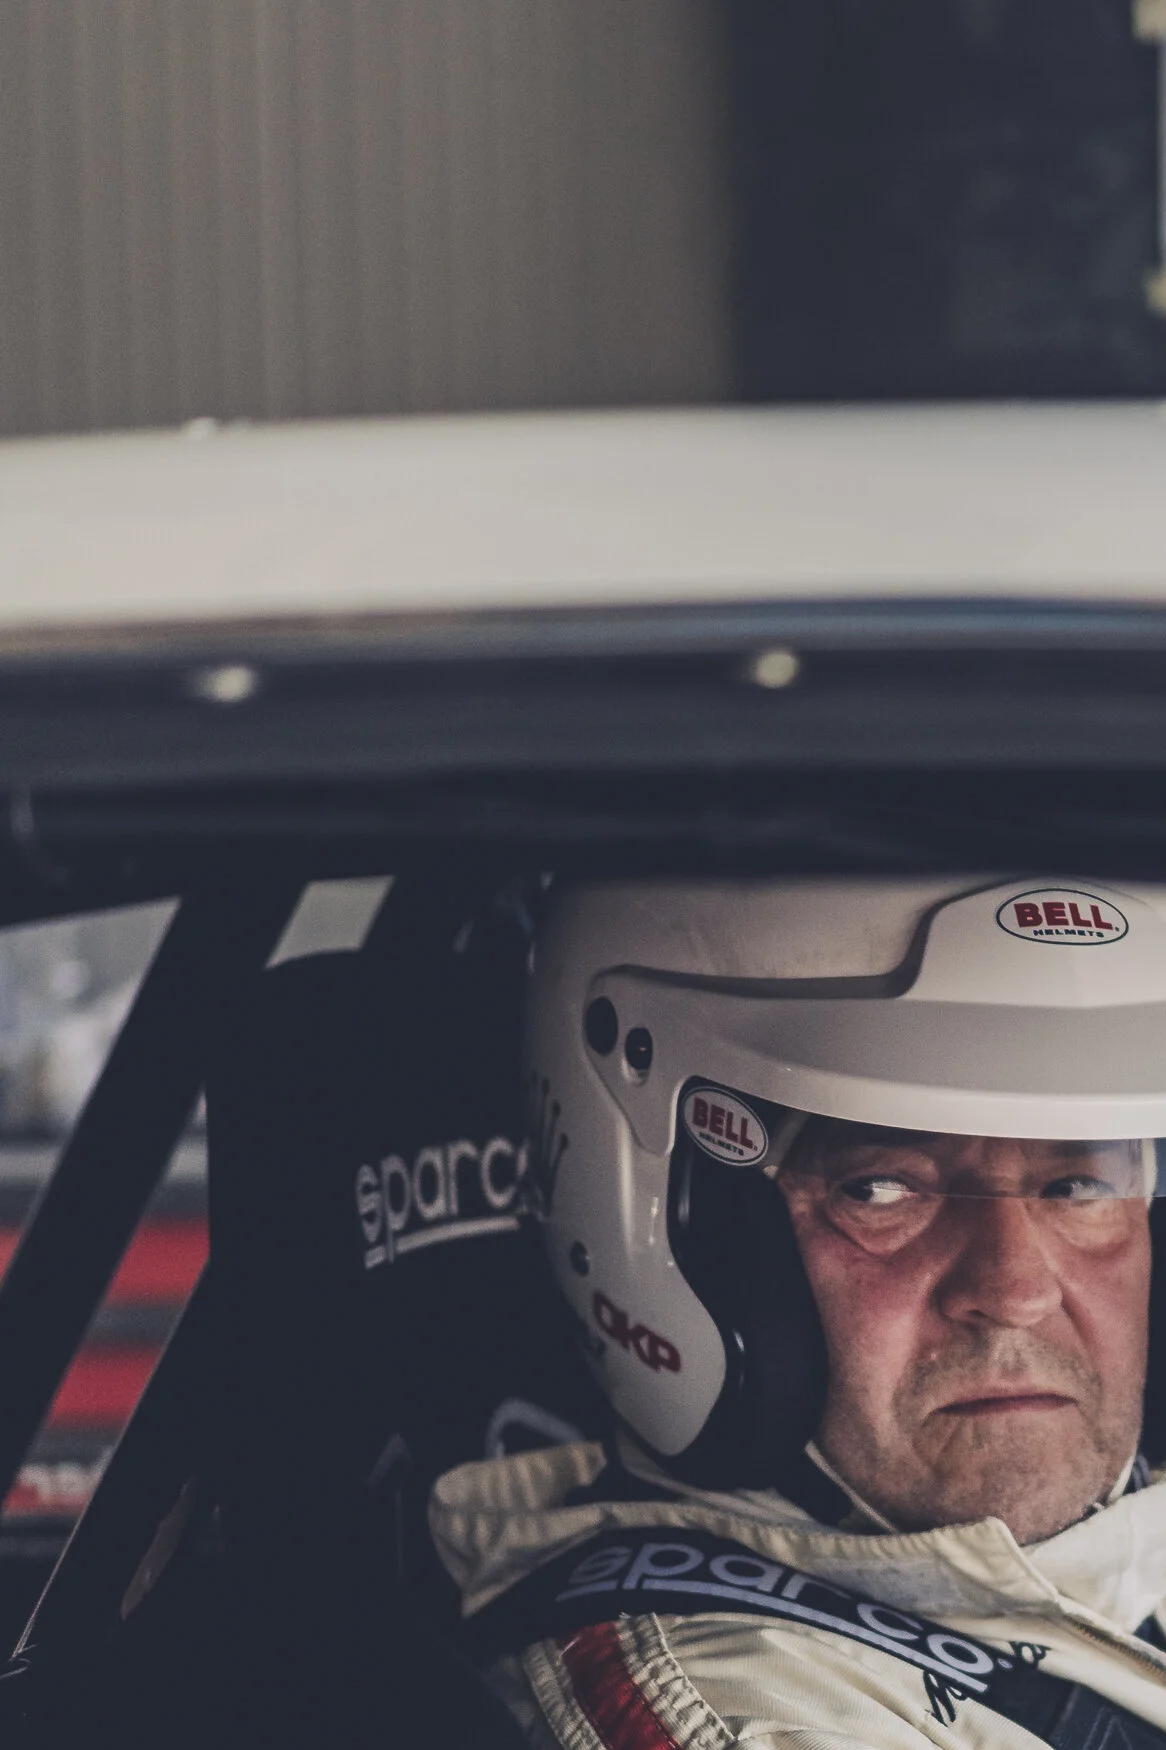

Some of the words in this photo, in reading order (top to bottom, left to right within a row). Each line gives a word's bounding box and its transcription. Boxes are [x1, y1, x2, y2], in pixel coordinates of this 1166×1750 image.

[1013, 901, 1114, 931] BELL
[1032, 928, 1105, 938] HELMETS
[693, 1096, 754, 1149] BELL
[567, 1542, 994, 1676] sparco
